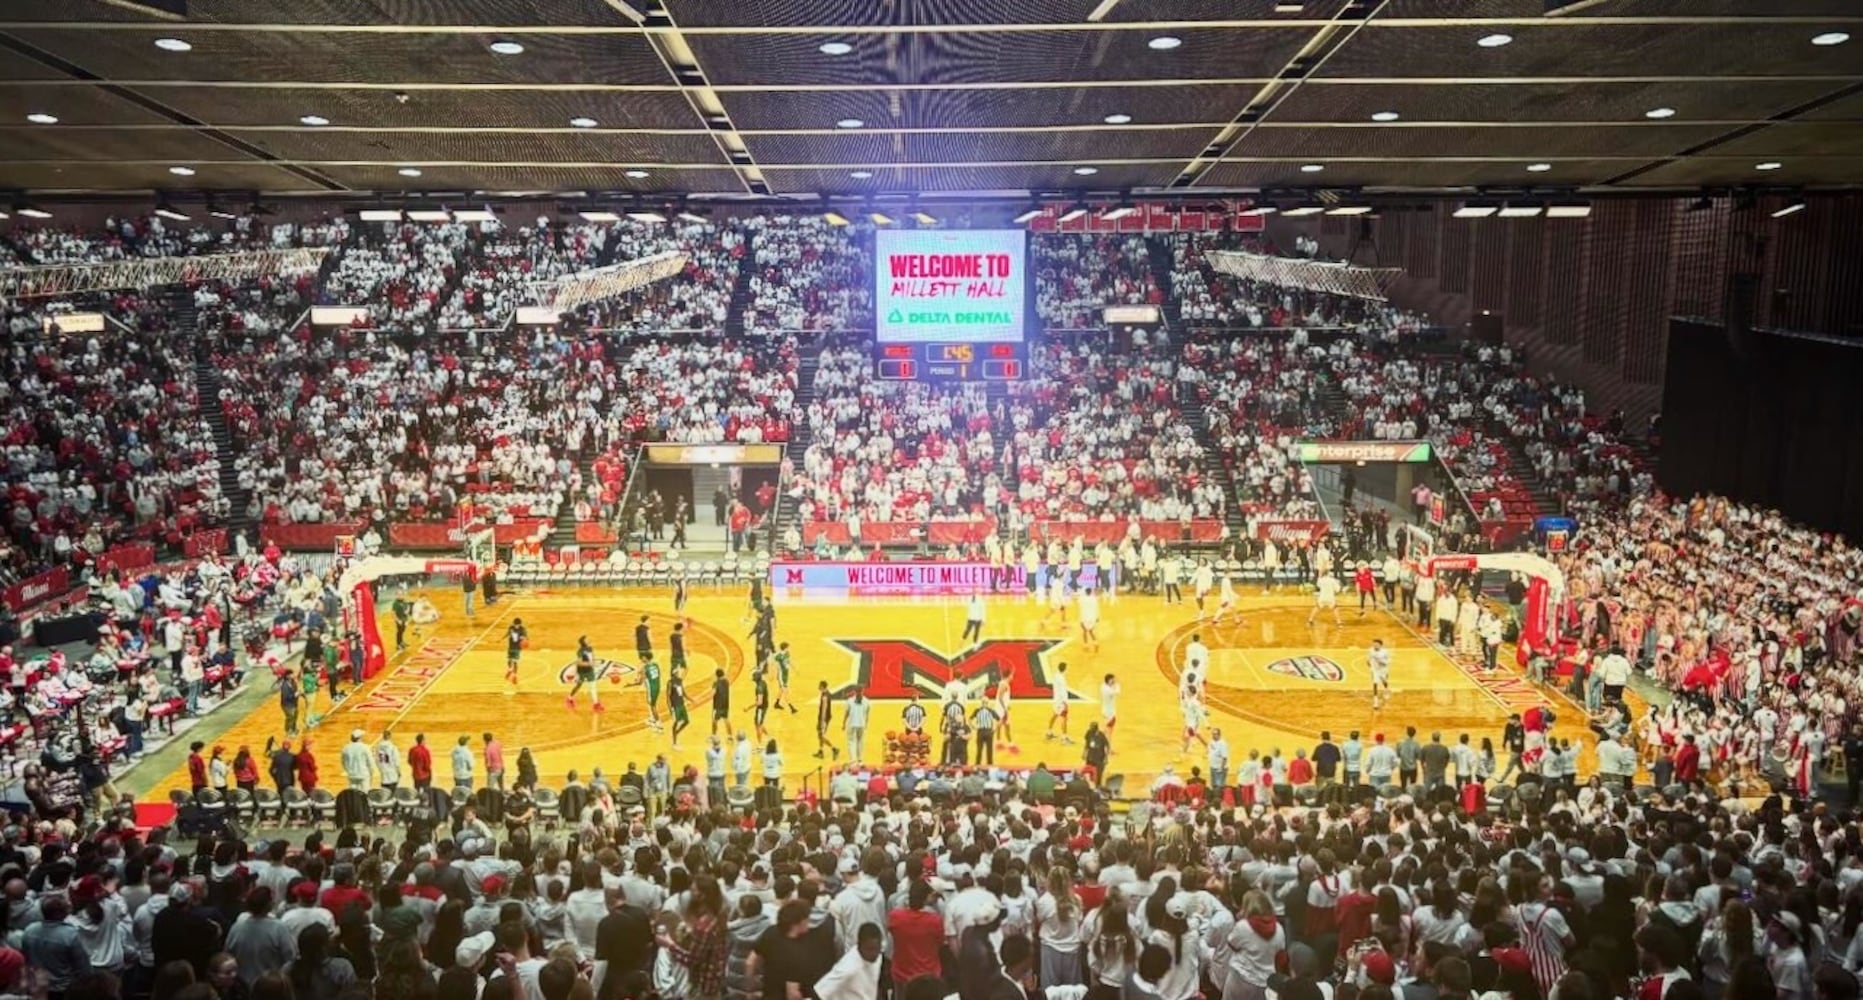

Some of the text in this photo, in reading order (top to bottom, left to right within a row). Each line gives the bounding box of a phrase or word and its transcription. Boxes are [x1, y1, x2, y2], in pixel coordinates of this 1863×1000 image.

[890, 255, 1010, 278] WELCOME TO
[890, 281, 1007, 298] MILLETT HALL
[908, 312, 1012, 324] DELTA DENTAL
[1302, 445, 1395, 459] enterprise
[1267, 523, 1315, 540] Miami
[786, 568, 803, 584] M
[847, 566, 914, 584] WELCOME
[919, 566, 936, 584] TO
[20, 576, 50, 602] Miami
[828, 638, 1084, 700] M
